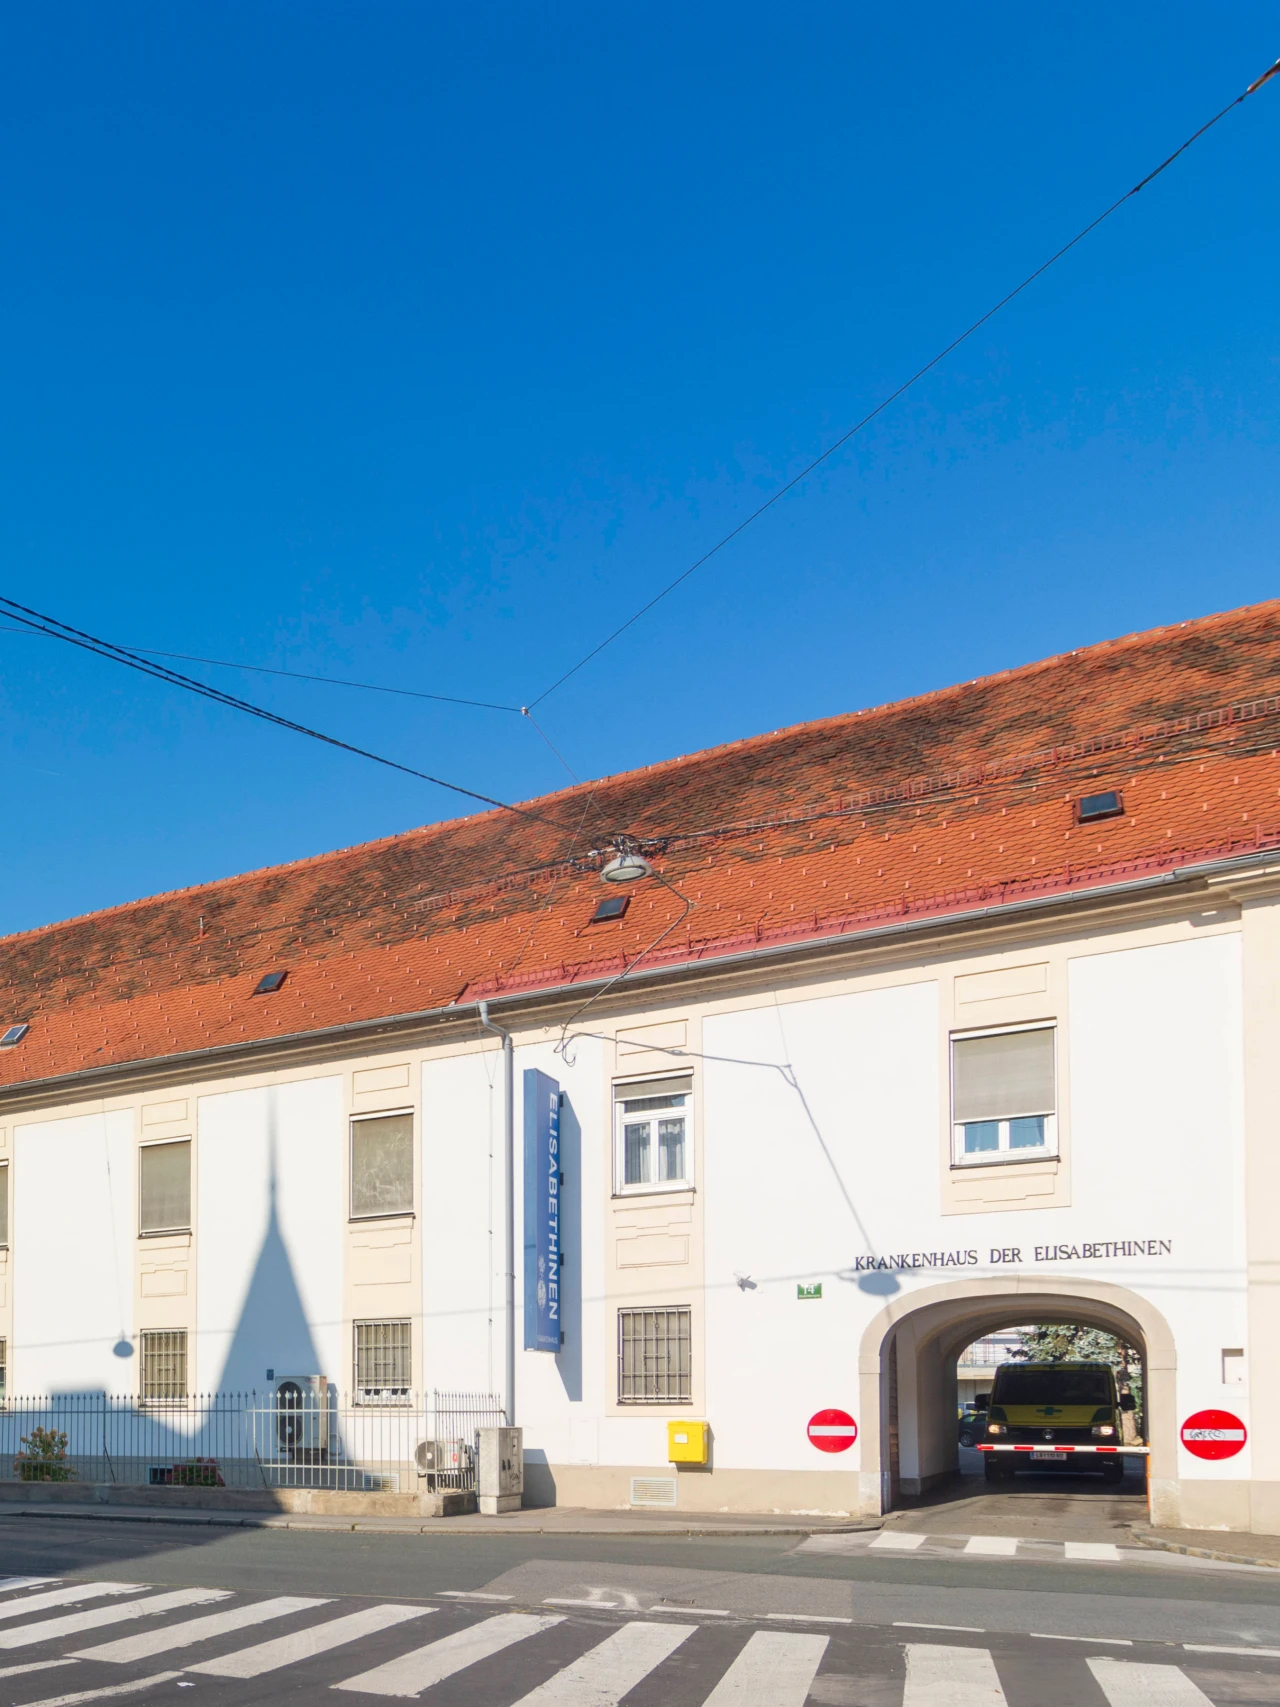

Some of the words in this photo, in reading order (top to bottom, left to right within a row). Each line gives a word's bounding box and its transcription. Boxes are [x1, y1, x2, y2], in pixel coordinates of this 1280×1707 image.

[548, 1092, 558, 1319] ELISABETHINEN
[855, 1250, 978, 1270] KRANKENHAUS
[989, 1248, 1023, 1263] DER
[1034, 1240, 1172, 1261] ELISABETHINEN
